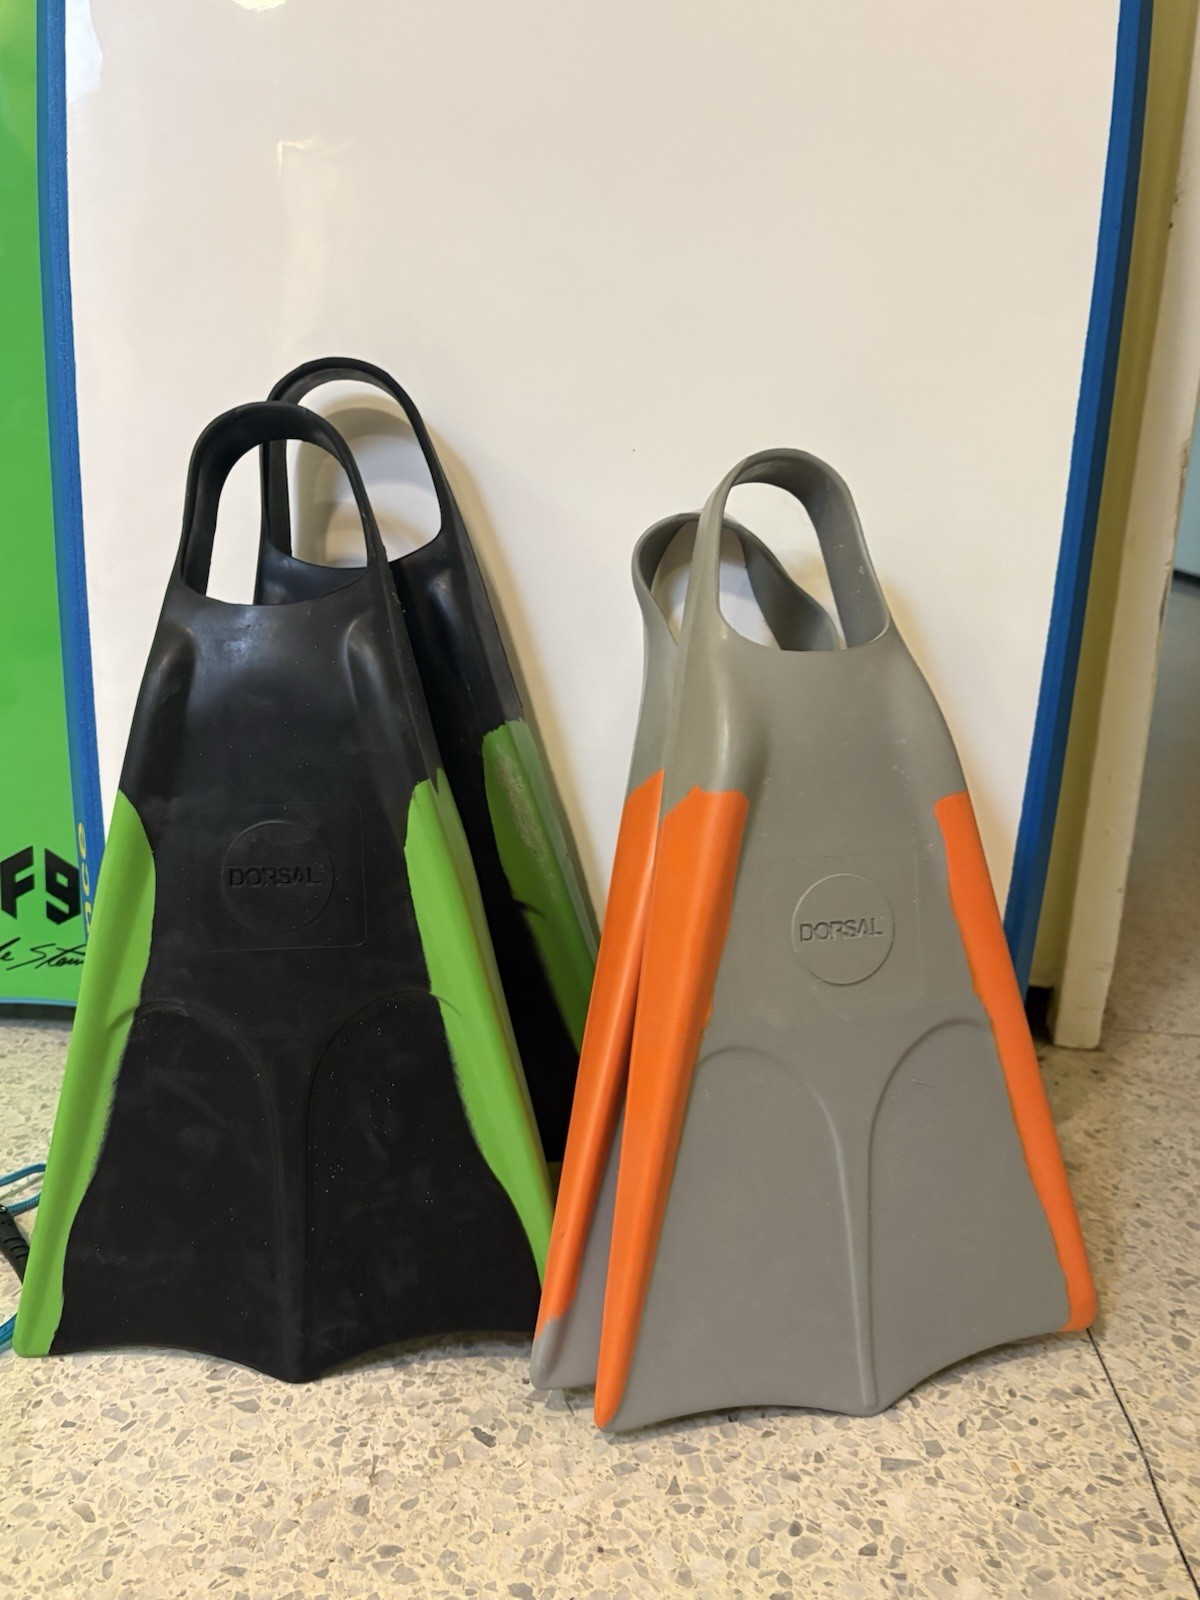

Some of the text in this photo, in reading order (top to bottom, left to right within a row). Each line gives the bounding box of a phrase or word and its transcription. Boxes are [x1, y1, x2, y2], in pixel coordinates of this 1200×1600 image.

[0, 845, 81, 925] F9
[228, 866, 321, 887] DORSAL
[800, 917, 884, 942] DORSAL
